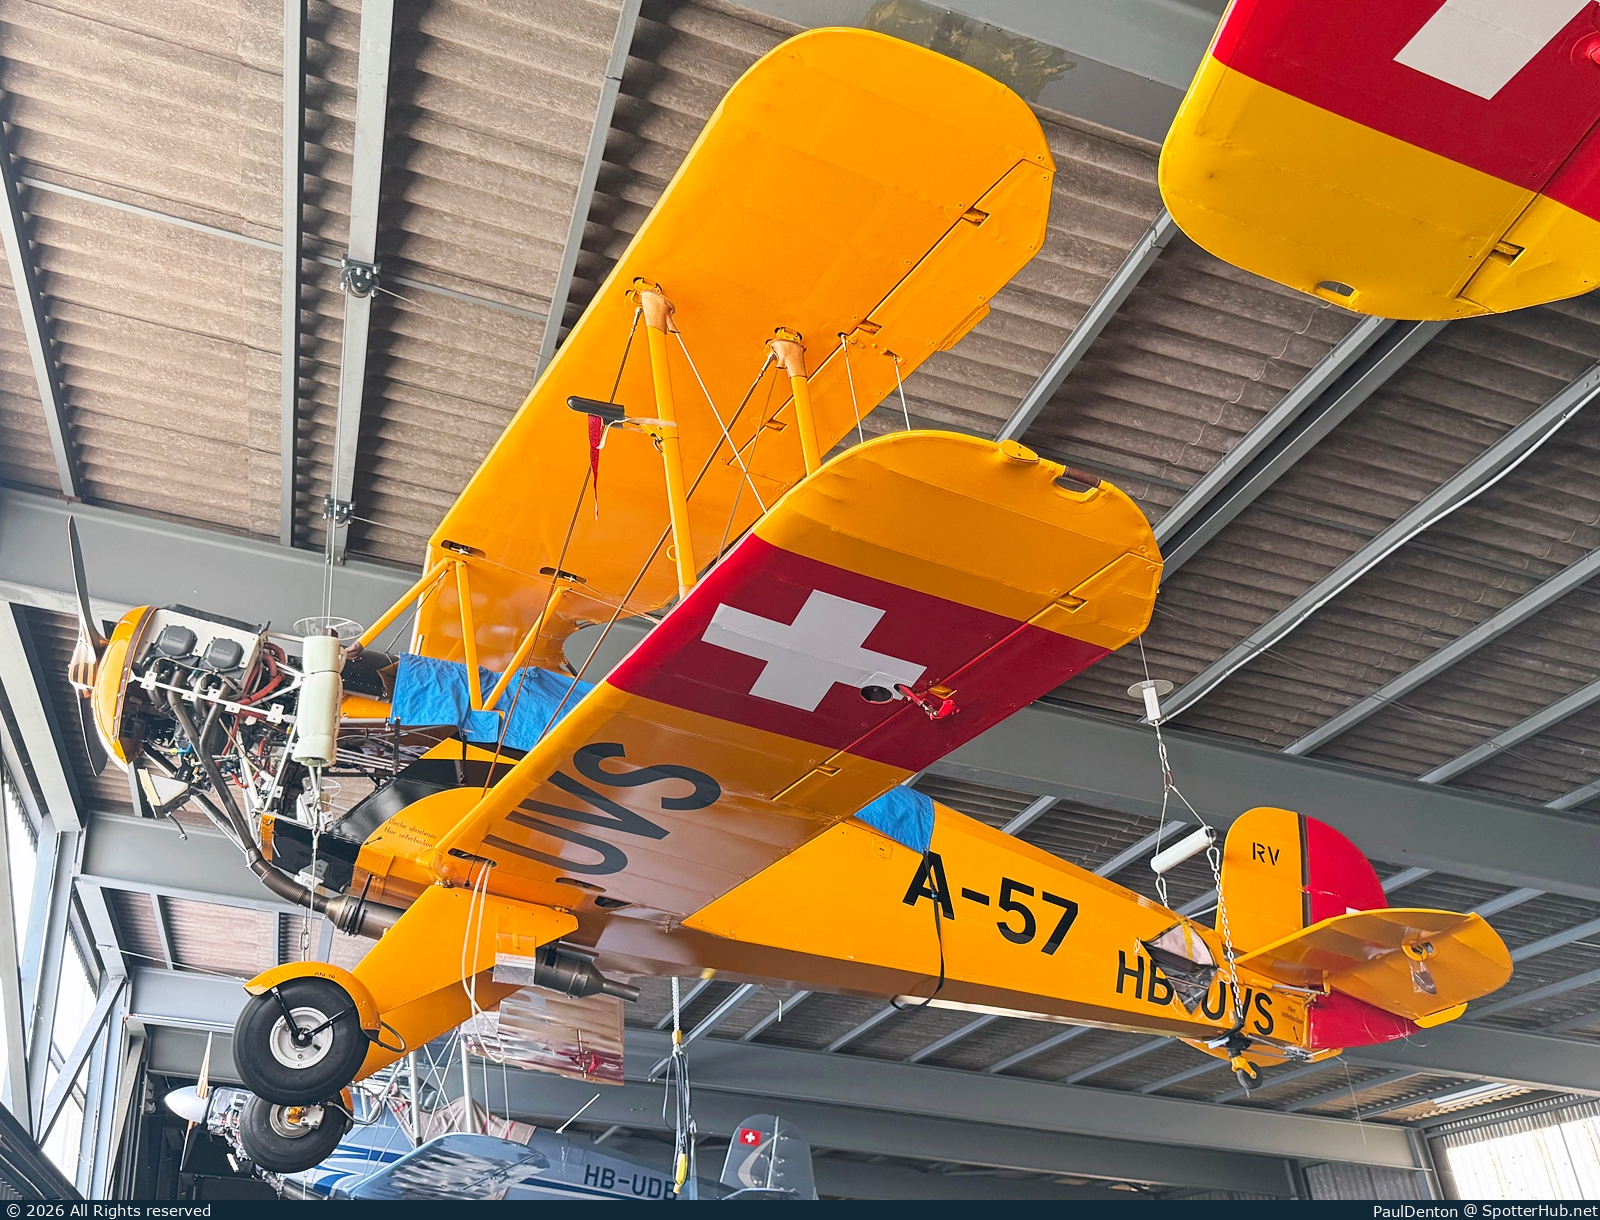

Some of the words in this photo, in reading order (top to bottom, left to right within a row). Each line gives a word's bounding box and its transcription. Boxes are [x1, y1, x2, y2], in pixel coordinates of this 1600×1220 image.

[481, 742, 722, 875] UVS
[1252, 841, 1280, 866] RV
[902, 850, 1079, 956] A-57
[584, 1164, 678, 1200] HB-UDB
